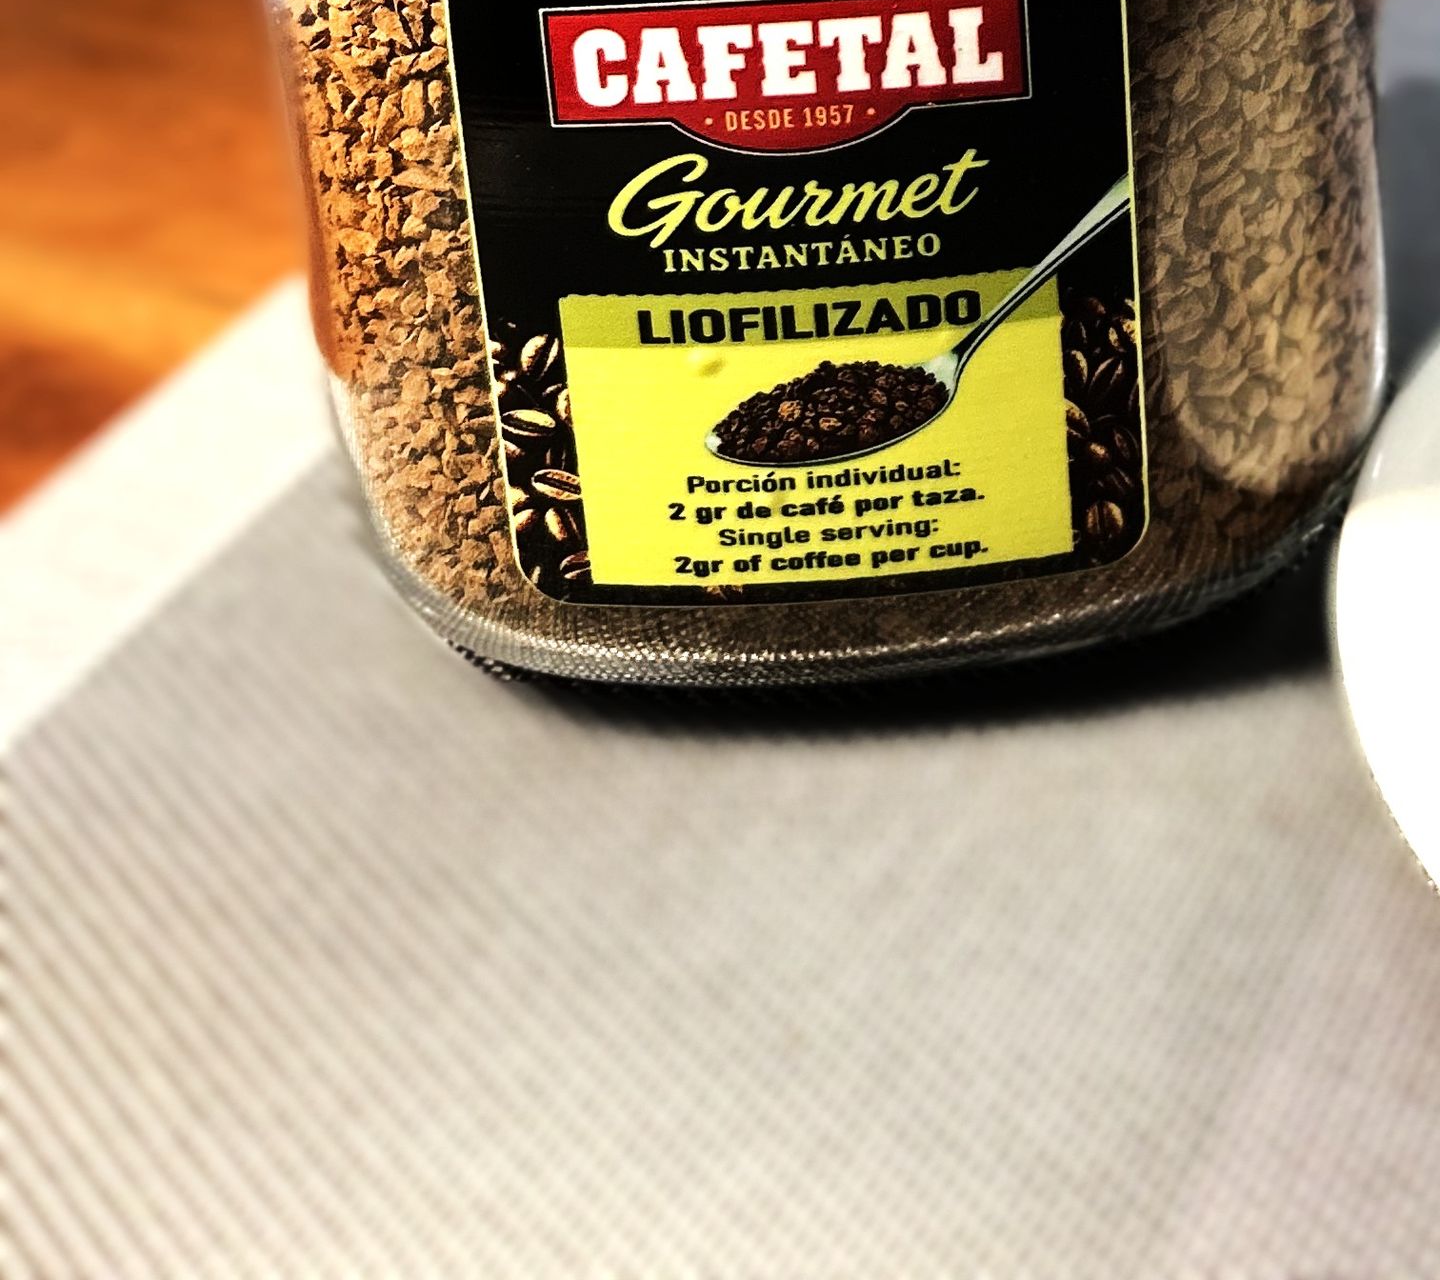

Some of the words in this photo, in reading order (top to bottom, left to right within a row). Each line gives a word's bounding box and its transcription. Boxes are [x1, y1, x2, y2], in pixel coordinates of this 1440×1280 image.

[572, 6, 1005, 108] CAFETAL
[724, 108, 796, 132] DESDE
[803, 104, 855, 128] 1957
[606, 148, 990, 249] Gourmet
[663, 233, 942, 273] INSTANTÁNEO
[637, 289, 982, 345] LIOFILIZADO
[687, 470, 796, 494] Porción
[807, 459, 961, 489] individual:
[668, 502, 686, 521] 2
[695, 505, 727, 524] gr
[736, 501, 772, 520] de
[780, 495, 845, 517] café
[855, 493, 903, 516] por
[912, 486, 985, 506] taza.
[718, 525, 811, 549] Single
[820, 517, 939, 542] serving:
[674, 555, 723, 578] 2gr
[733, 553, 762, 572] of
[770, 549, 861, 571] coffee
[871, 545, 920, 569] per
[929, 539, 988, 559] cup.
